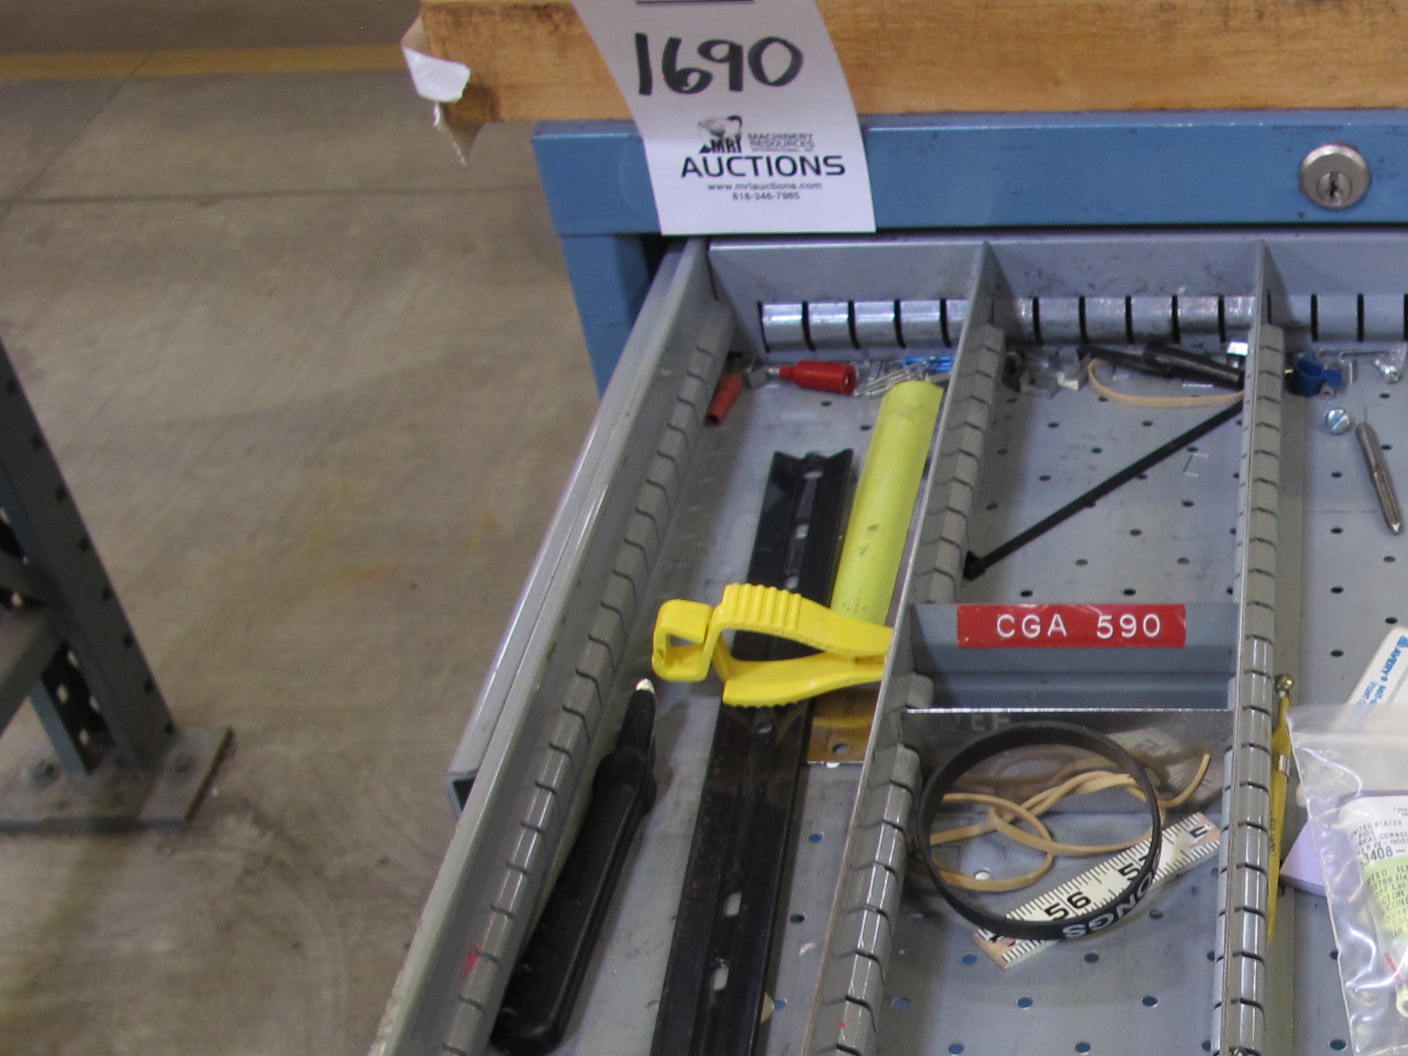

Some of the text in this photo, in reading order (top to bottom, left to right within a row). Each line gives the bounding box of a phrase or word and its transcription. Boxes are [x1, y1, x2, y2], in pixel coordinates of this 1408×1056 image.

[634, 32, 804, 96] 1690
[681, 155, 846, 178] AUCTIONS
[996, 614, 1161, 639] CGA 590
[1044, 891, 1092, 921] 56
